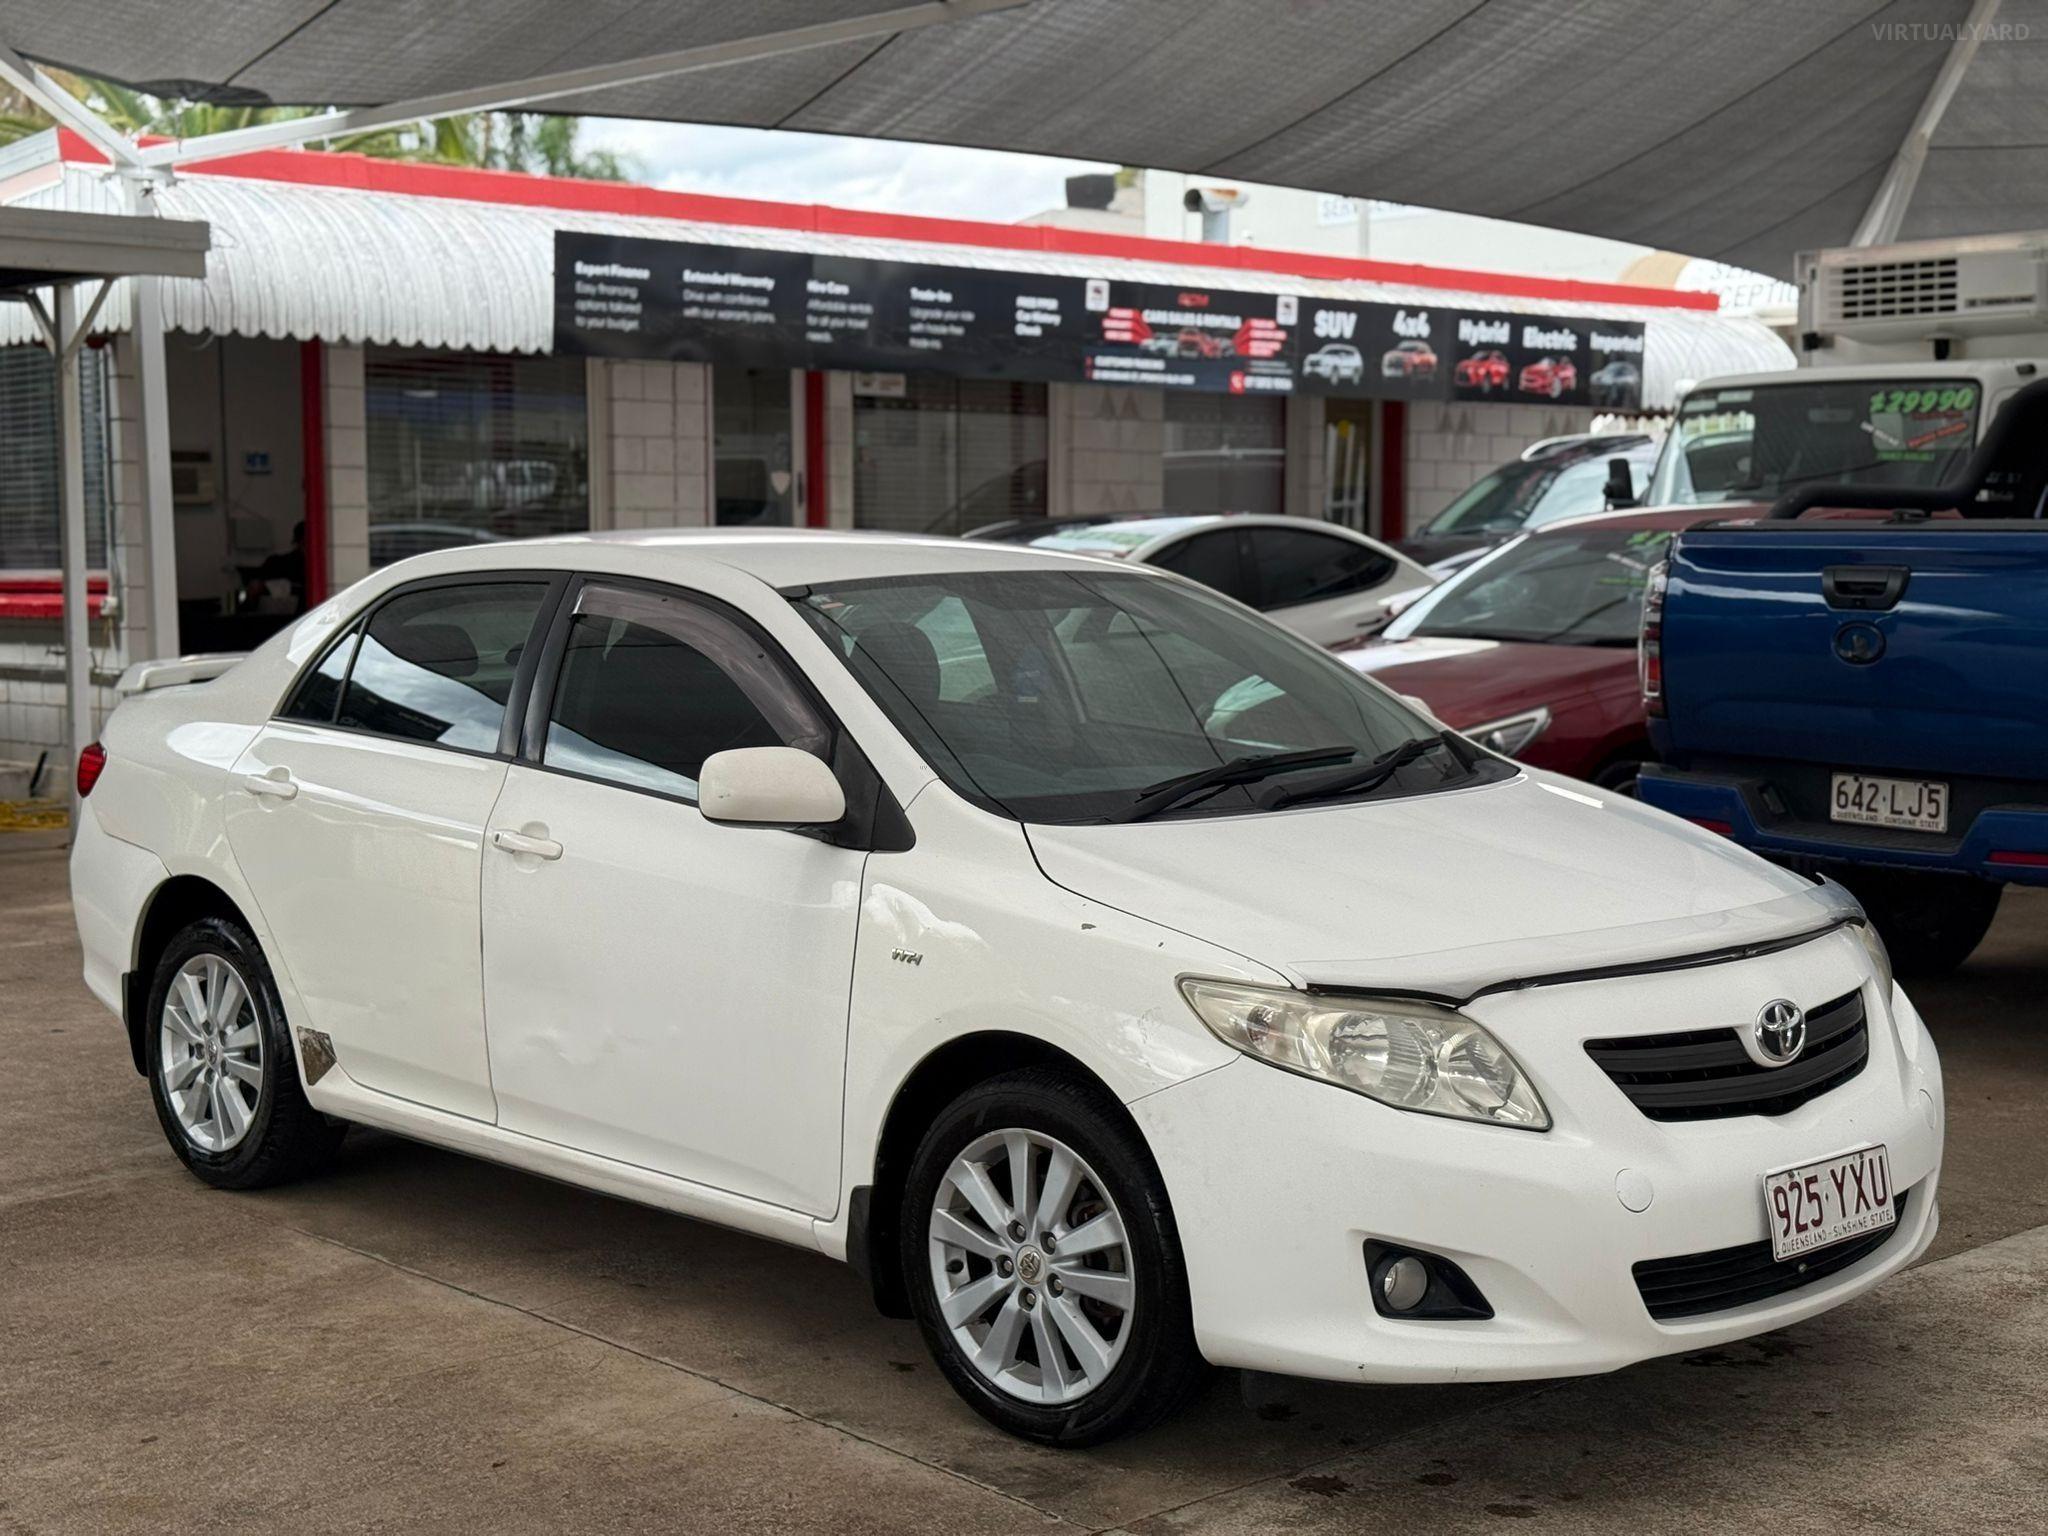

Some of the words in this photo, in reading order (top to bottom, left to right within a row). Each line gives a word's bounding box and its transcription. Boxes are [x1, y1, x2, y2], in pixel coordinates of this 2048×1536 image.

[1313, 309, 1357, 338] SUV
[1458, 317, 1511, 346] Hybrid
[1522, 326, 1577, 351] Electric
[1590, 331, 1643, 355] Imported
[1836, 811, 1879, 823] QUEENSLAND
[1885, 817, 1917, 828] SUNSHINE
[1920, 819, 1940, 829] STATE
[1782, 1229, 1827, 1254] QUEENSLAND
[1833, 1216, 1868, 1237] SUNSHINE
[1870, 1209, 1890, 1226] STATE
